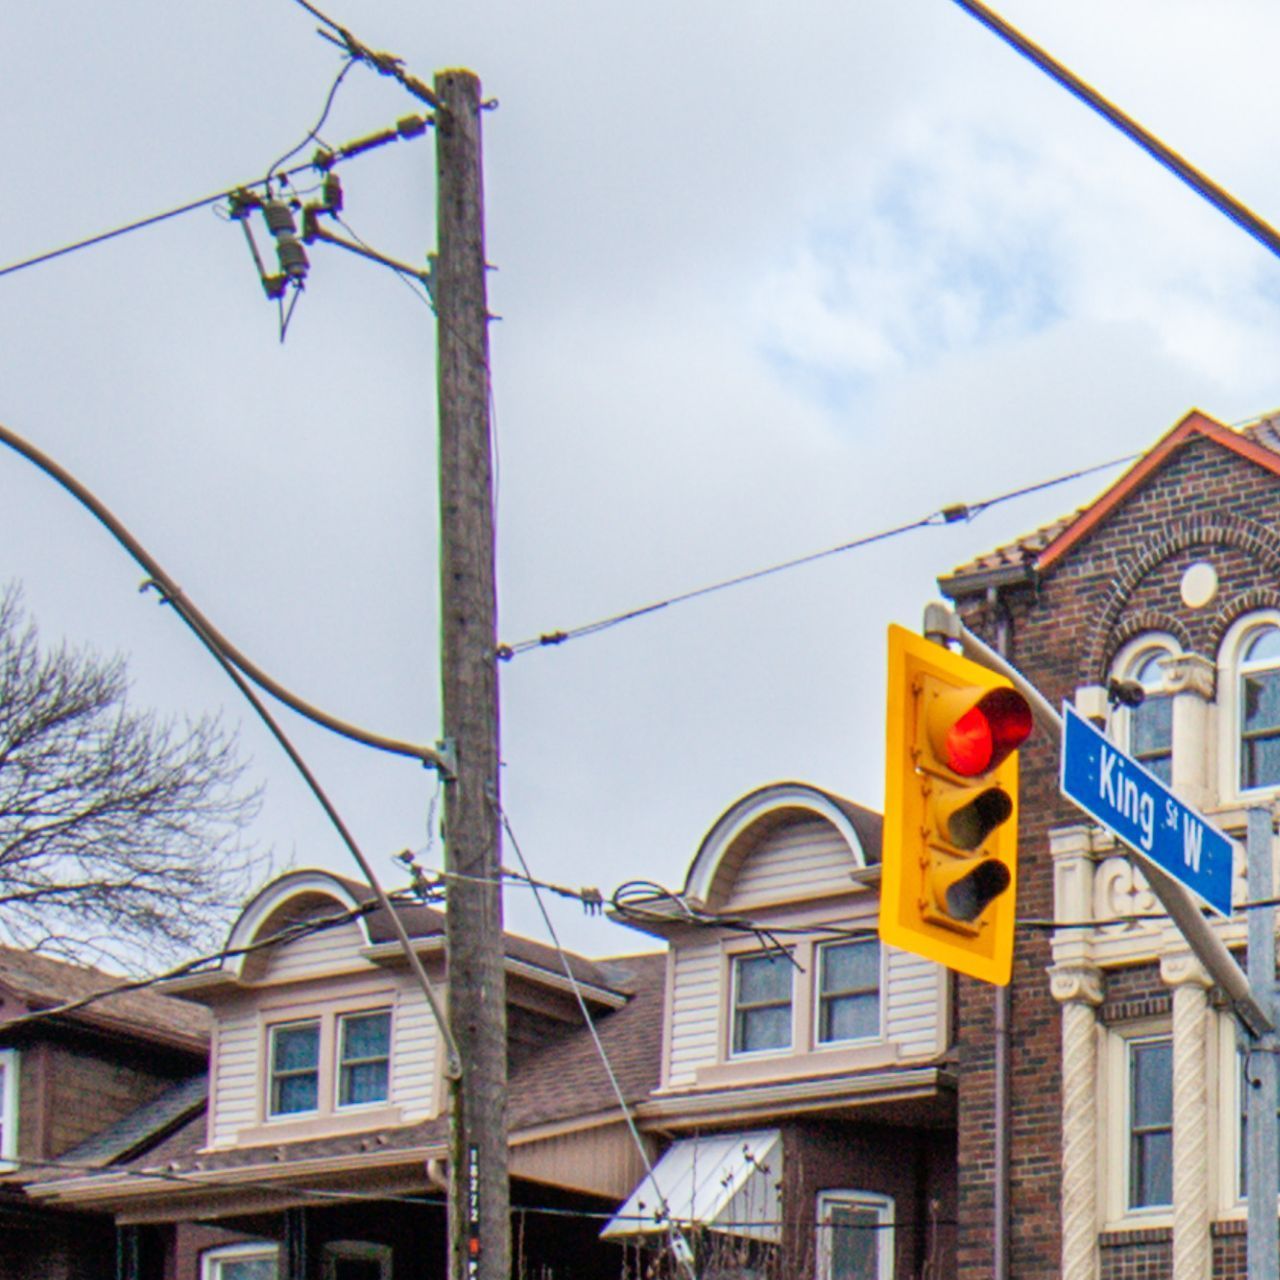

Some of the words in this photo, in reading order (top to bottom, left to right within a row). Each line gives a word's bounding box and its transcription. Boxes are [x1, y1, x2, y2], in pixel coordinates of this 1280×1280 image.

[1100, 744, 1154, 850] King
[1166, 799, 1178, 830] St
[1184, 812, 1203, 873] W
